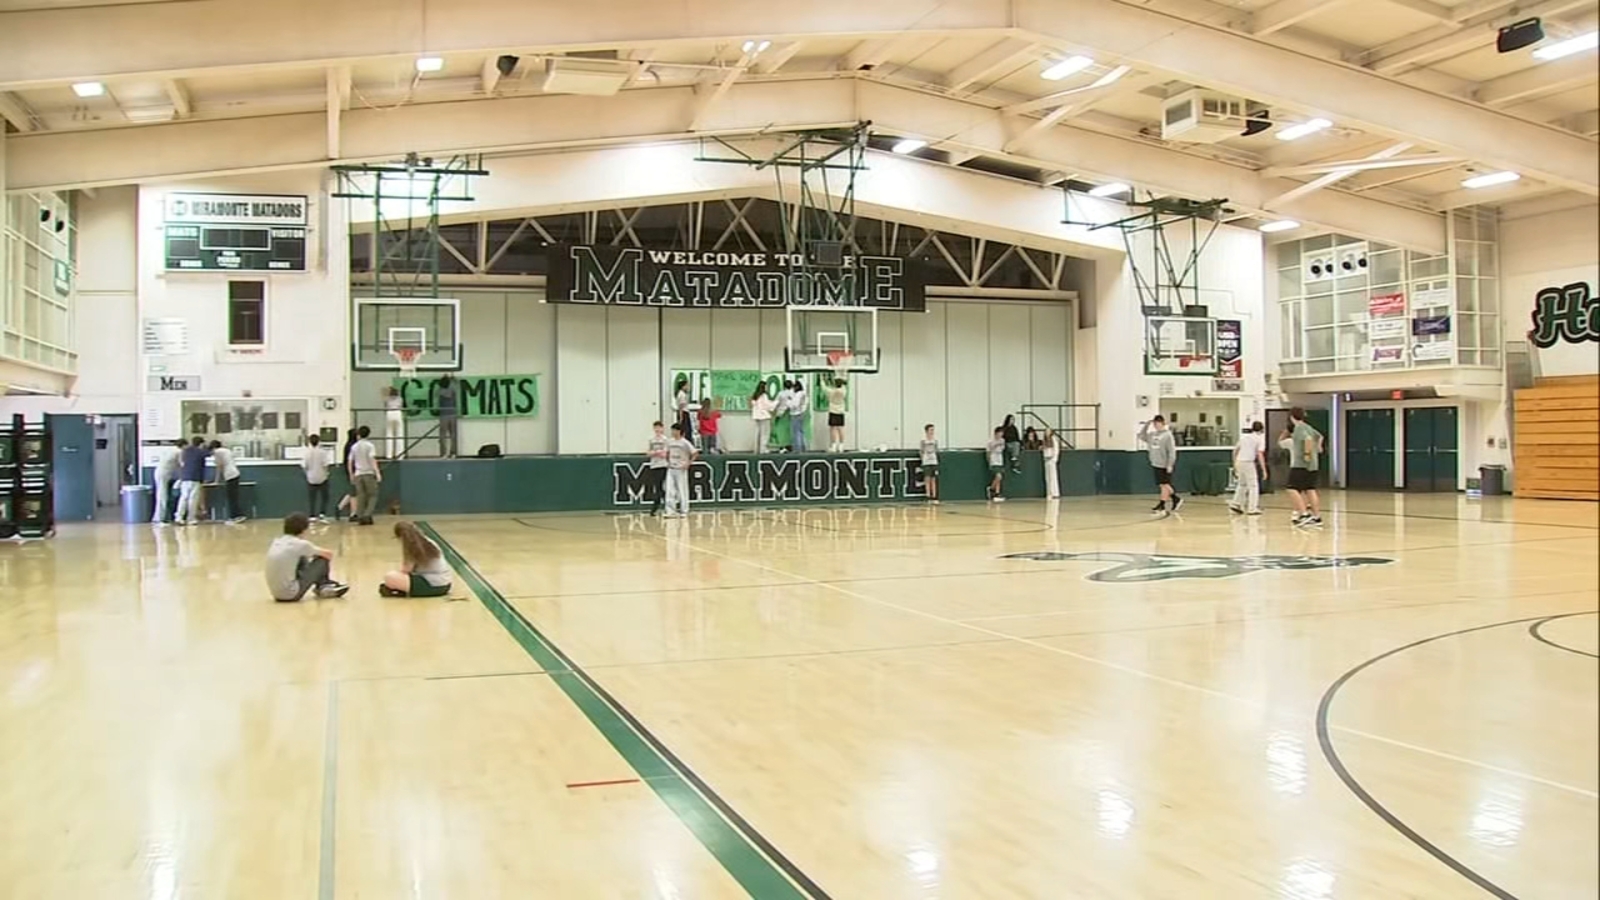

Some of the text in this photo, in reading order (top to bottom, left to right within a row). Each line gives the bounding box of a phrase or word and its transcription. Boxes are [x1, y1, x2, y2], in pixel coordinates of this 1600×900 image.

[192, 201, 302, 218] MIRAMONTE MATADORS
[648, 250, 766, 267] WELCOME
[774, 253, 804, 267] TO
[570, 246, 904, 310] MATADOME
[460, 378, 535, 416] MATS
[613, 458, 928, 505] MRAMONTE
